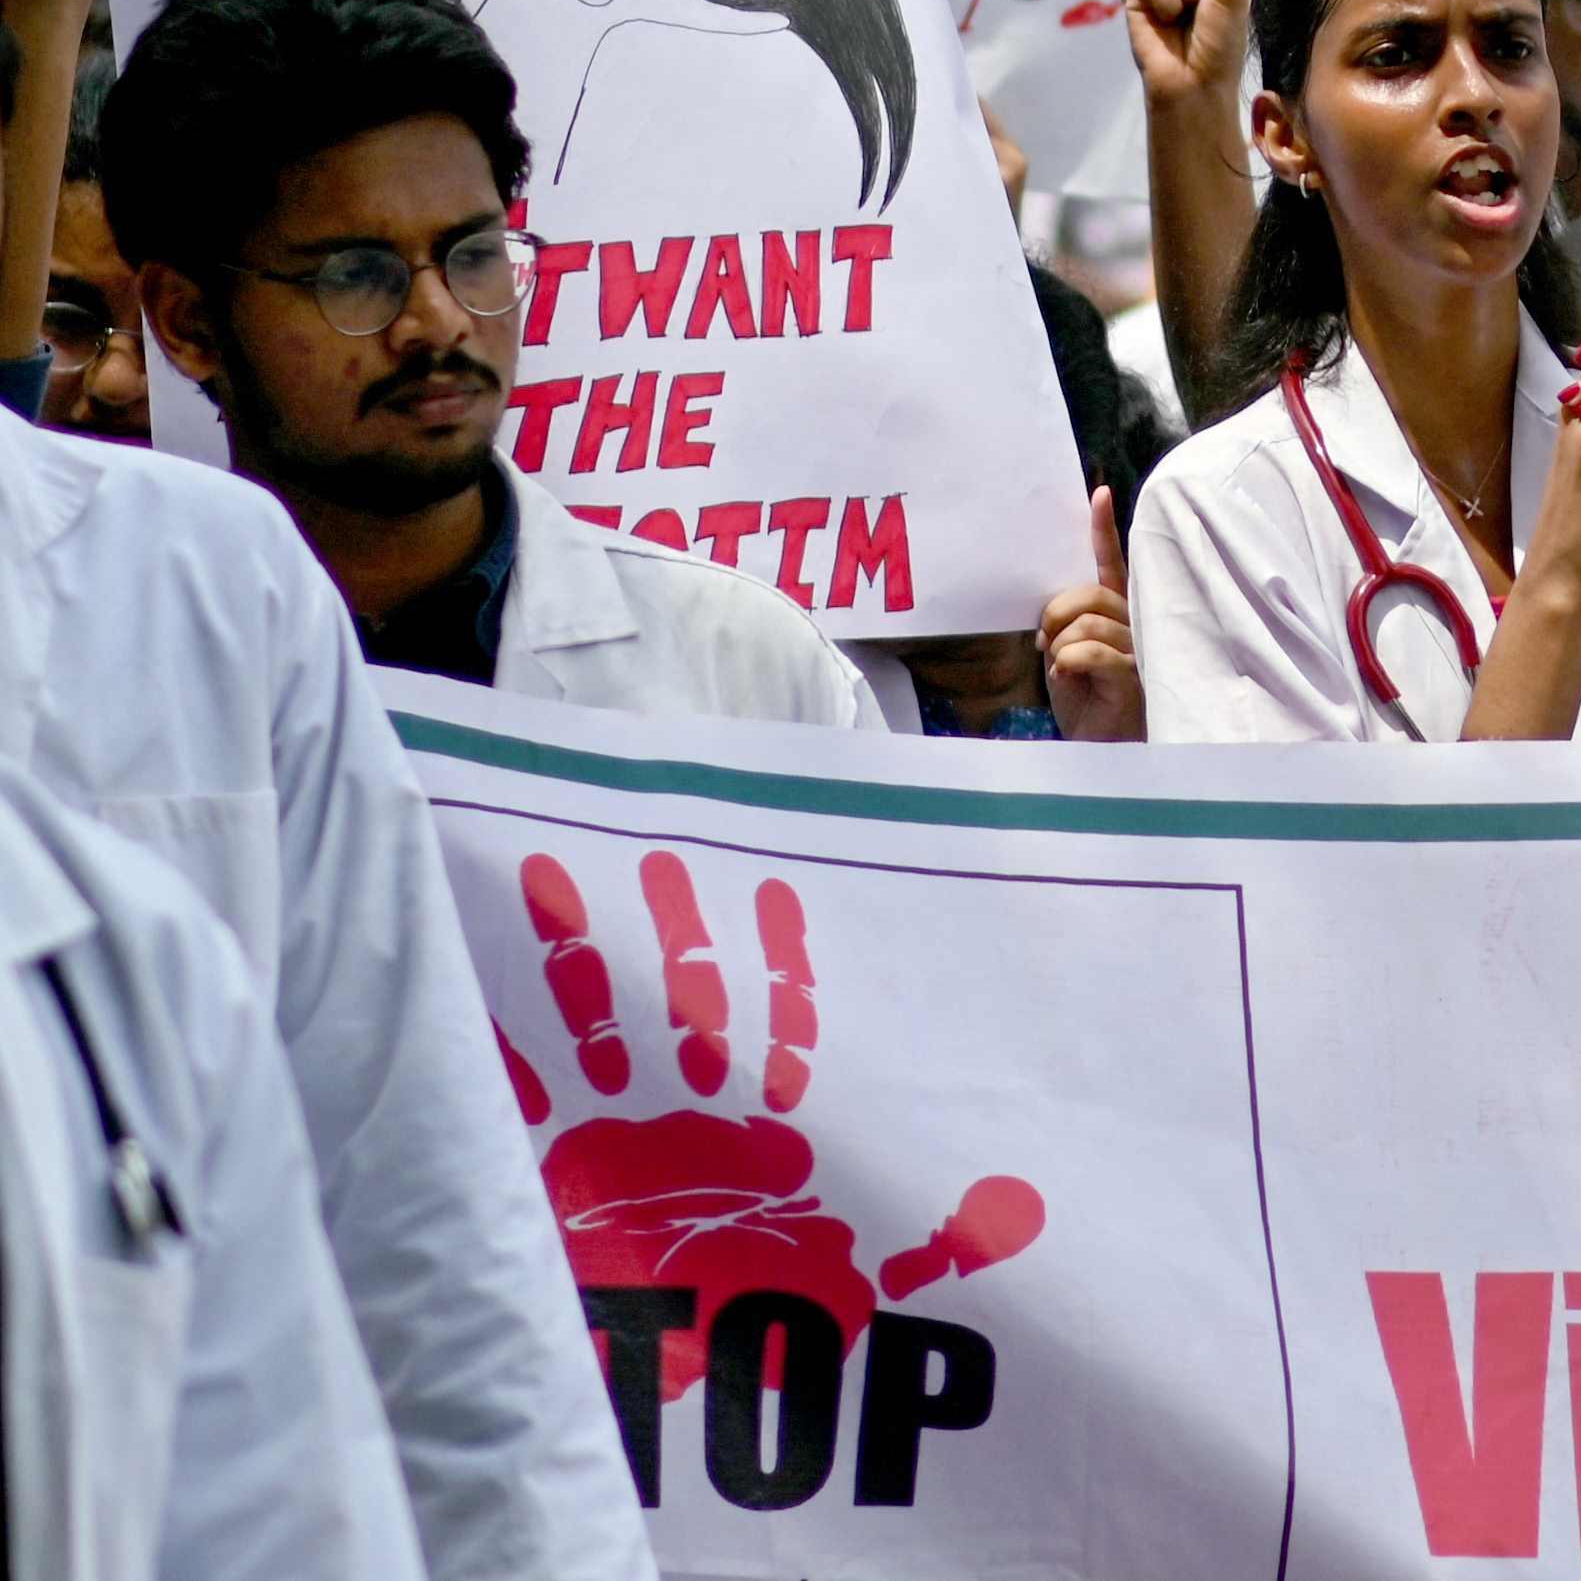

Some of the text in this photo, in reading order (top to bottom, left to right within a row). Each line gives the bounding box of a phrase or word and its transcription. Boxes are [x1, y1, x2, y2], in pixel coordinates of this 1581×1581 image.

[600, 225, 894, 342] WANT
[508, 369, 726, 475] THE
[577, 1284, 998, 1513] TOP
